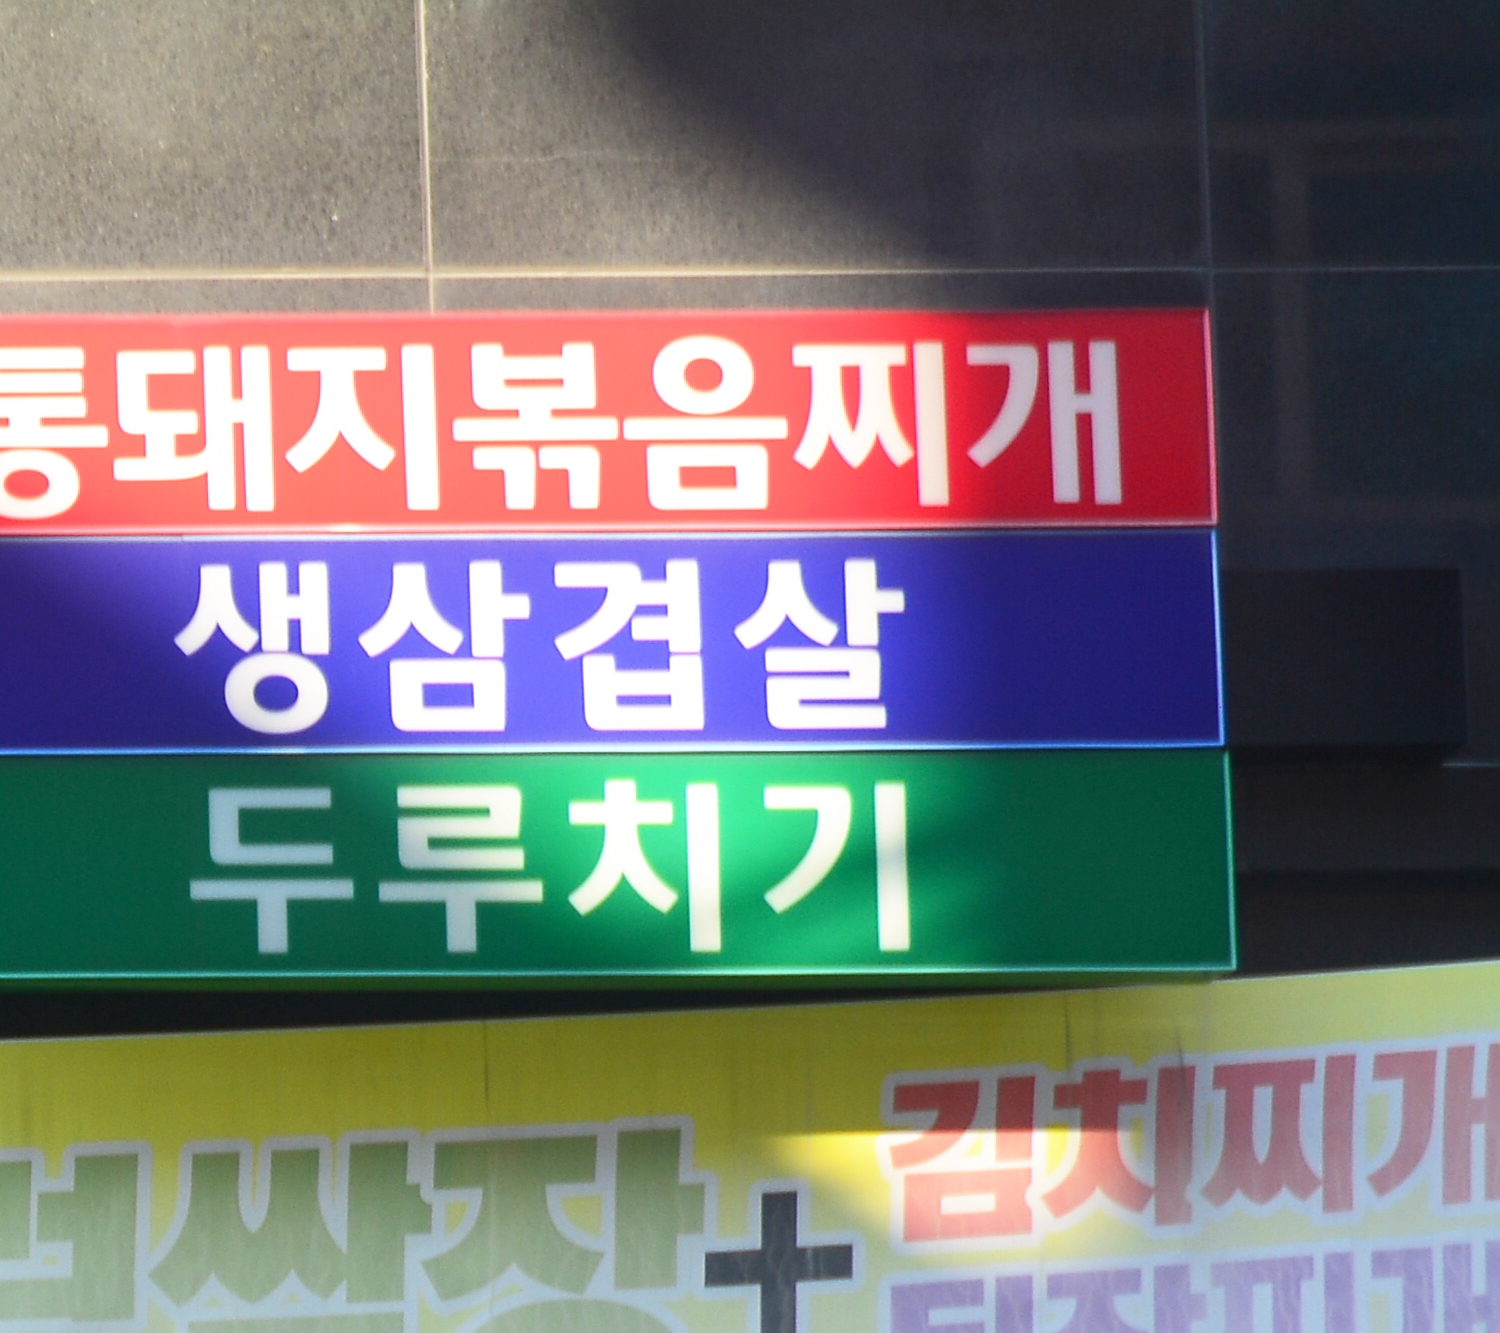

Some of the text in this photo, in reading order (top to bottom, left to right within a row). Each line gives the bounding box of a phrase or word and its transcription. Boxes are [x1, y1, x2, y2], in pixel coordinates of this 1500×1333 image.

[174, 558, 906, 732] 생삼겹살
[189, 777, 912, 954] 두루치기
[887, 1043, 1500, 1243] 김치찌개
